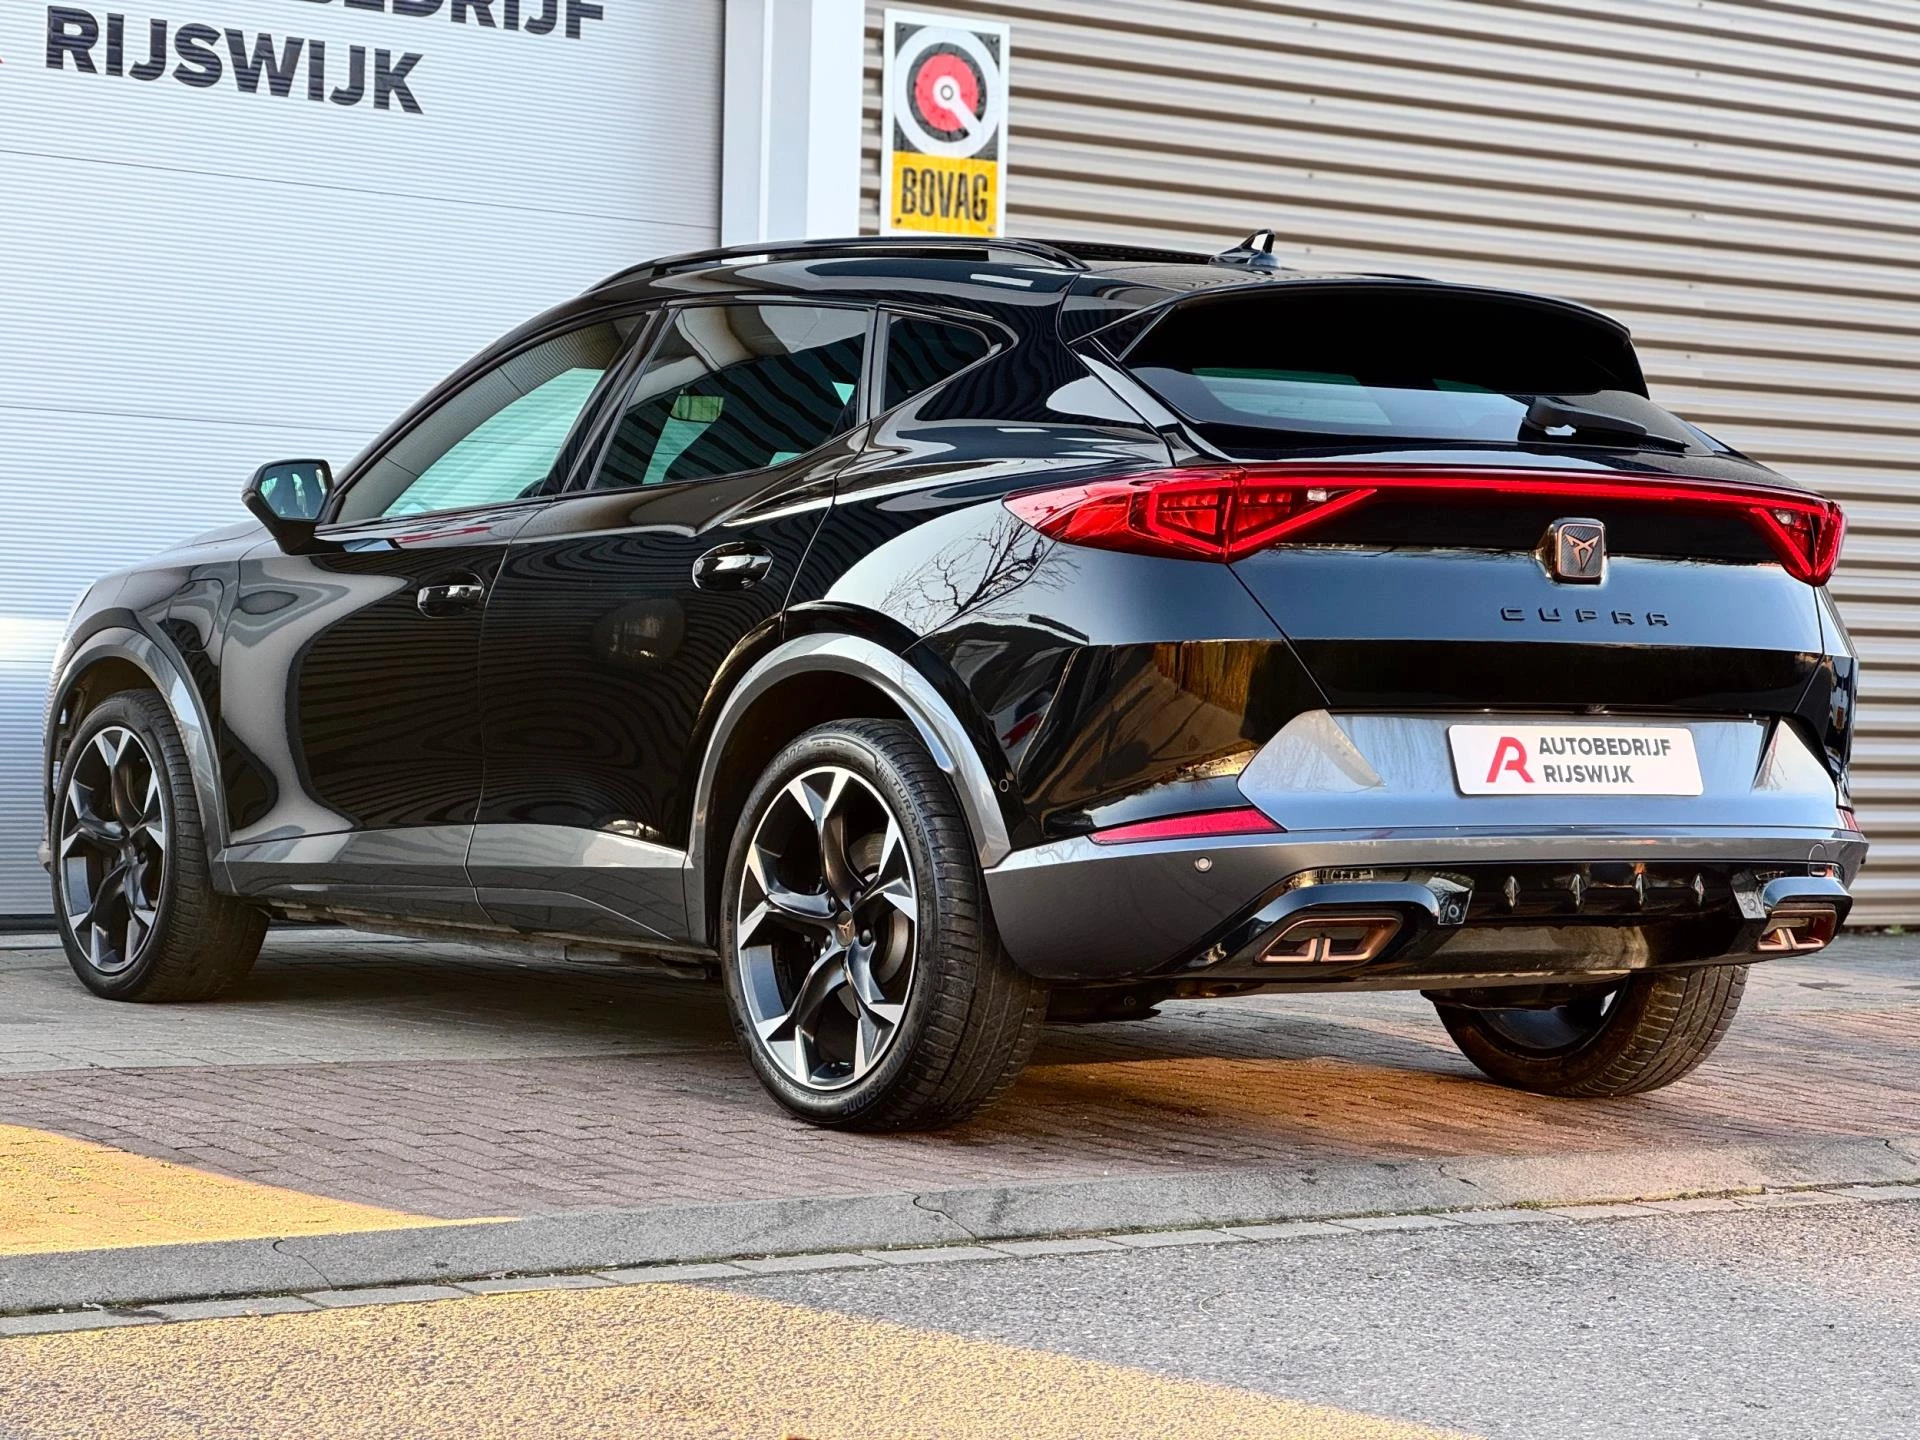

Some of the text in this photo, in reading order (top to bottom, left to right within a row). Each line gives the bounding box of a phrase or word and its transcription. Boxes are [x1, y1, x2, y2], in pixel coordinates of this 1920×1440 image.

[46, 5, 424, 114] RIJSWIJK
[901, 167, 989, 222] BOVAG
[1500, 607, 1670, 627] CUPRA
[1539, 736, 1672, 757] AUTOBEDRIJF
[1543, 764, 1635, 784] RIJSWIJK
[891, 777, 929, 863] TURANZA
